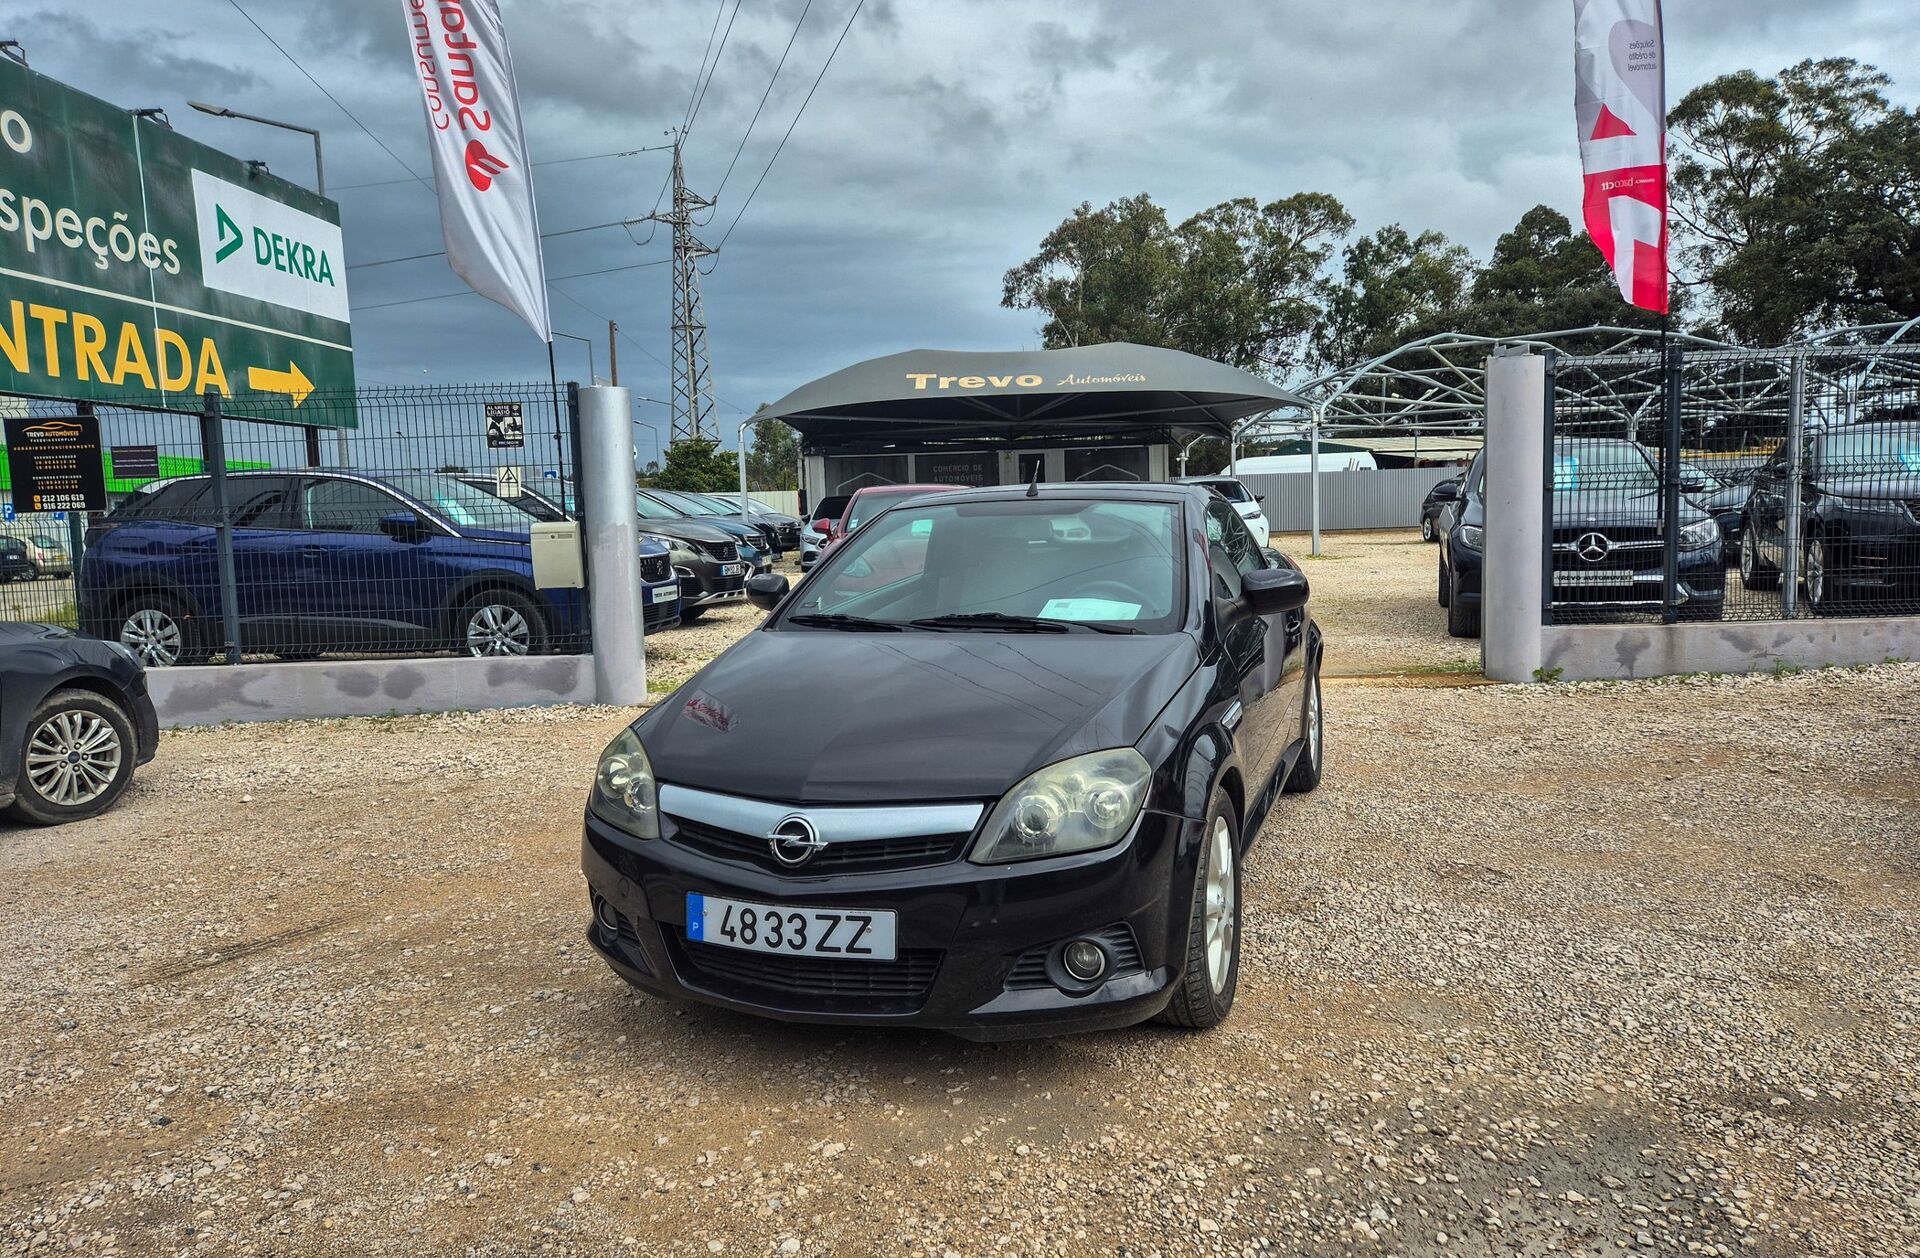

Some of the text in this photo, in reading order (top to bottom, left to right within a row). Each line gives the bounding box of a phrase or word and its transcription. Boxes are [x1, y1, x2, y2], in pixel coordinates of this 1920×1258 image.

[252, 226, 335, 287] DEKRA
[906, 373, 1147, 390] Trevo Automóveis
[933, 463, 983, 473] COMÉRCIO DE
[934, 473, 983, 482] AUTOMÓVEIS
[42, 493, 85, 502] 212 106 619
[43, 502, 56, 510] 916
[692, 922, 699, 931] P
